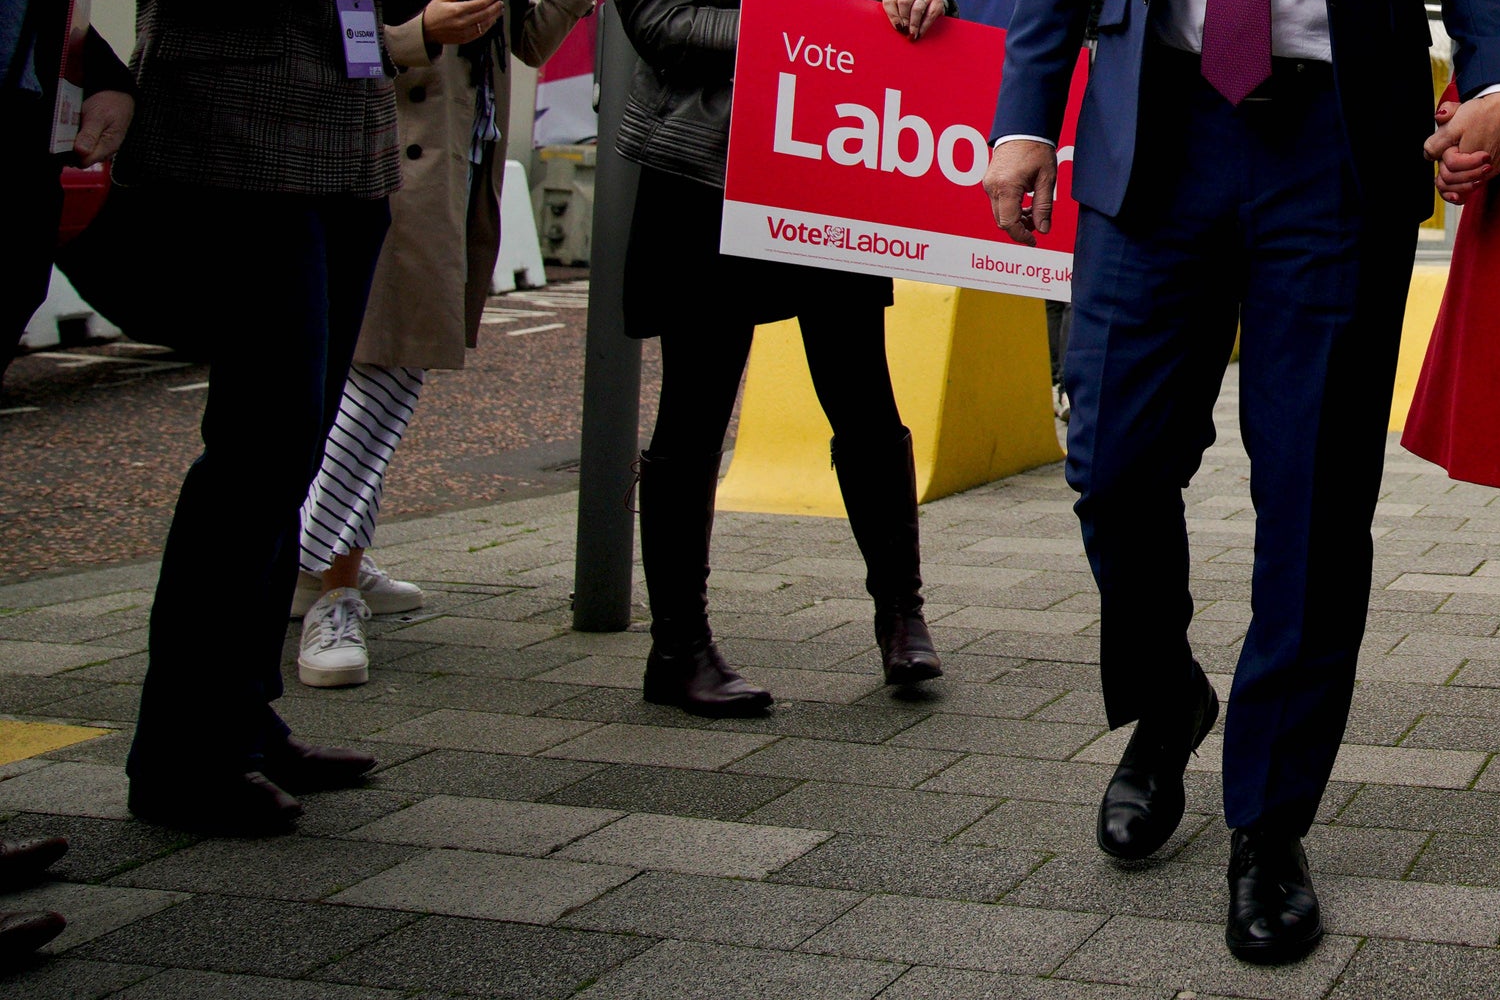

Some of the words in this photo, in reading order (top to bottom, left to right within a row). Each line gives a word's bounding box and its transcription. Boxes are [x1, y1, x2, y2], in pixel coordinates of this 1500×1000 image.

[782, 32, 855, 74] Vote
[767, 216, 822, 245] Vote
[844, 227, 929, 261] Labour
[971, 253, 1073, 283] labour.org.uk
